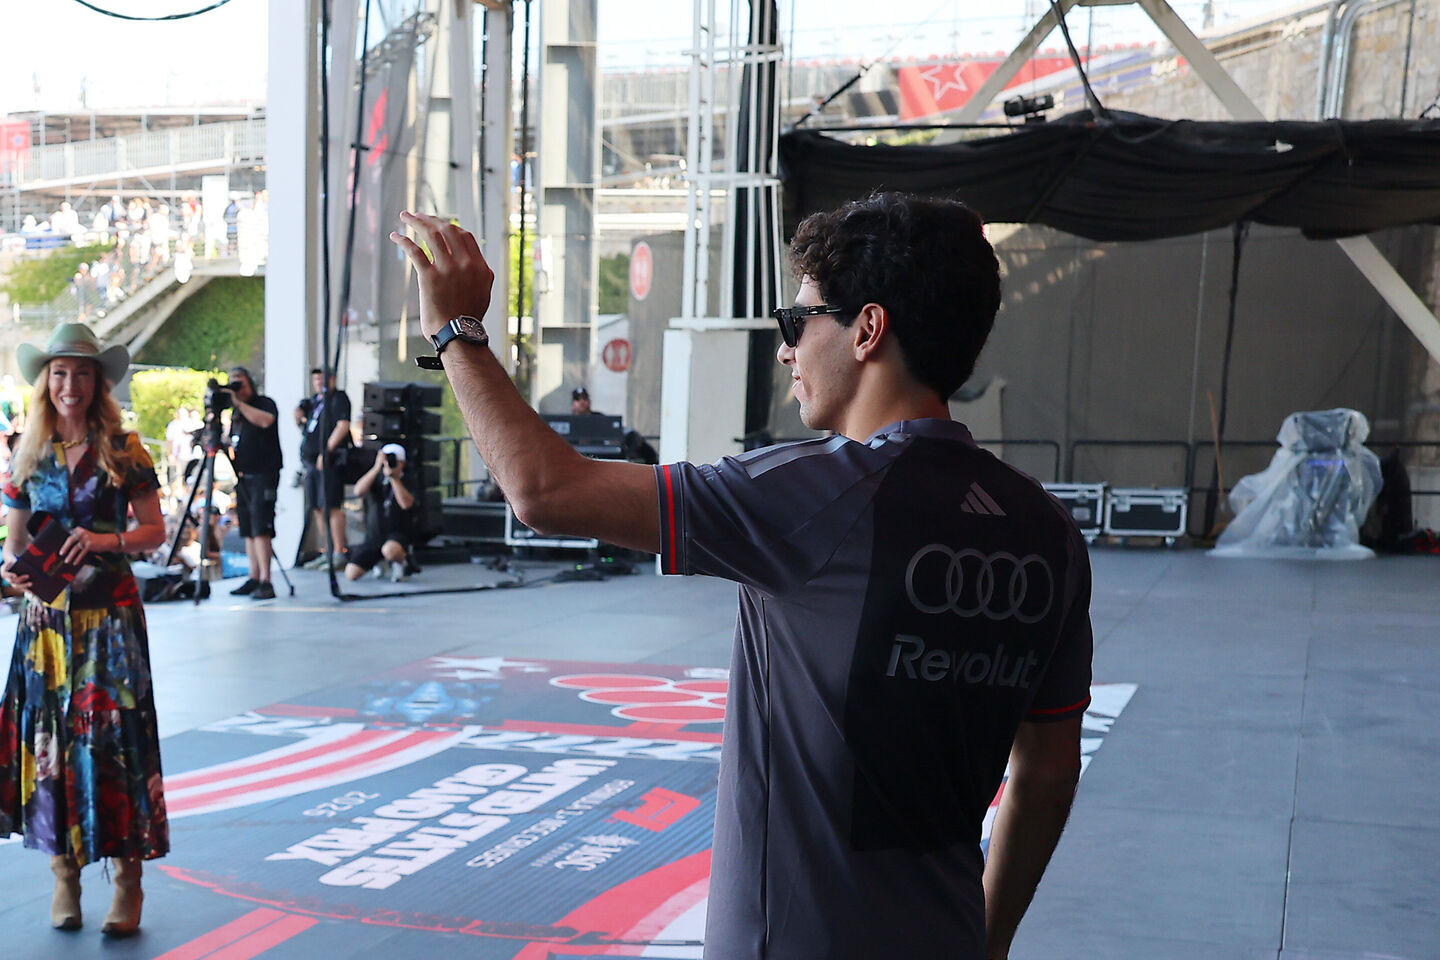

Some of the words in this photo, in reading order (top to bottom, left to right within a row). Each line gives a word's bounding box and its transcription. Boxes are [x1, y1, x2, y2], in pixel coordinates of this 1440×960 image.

[886, 633, 1038, 689] Revolut
[303, 791, 380, 818] 2025
[373, 763, 528, 820] GRAND
[468, 758, 618, 815] UNITED
[265, 815, 422, 866] PRIX
[319, 811, 511, 890] STATES
